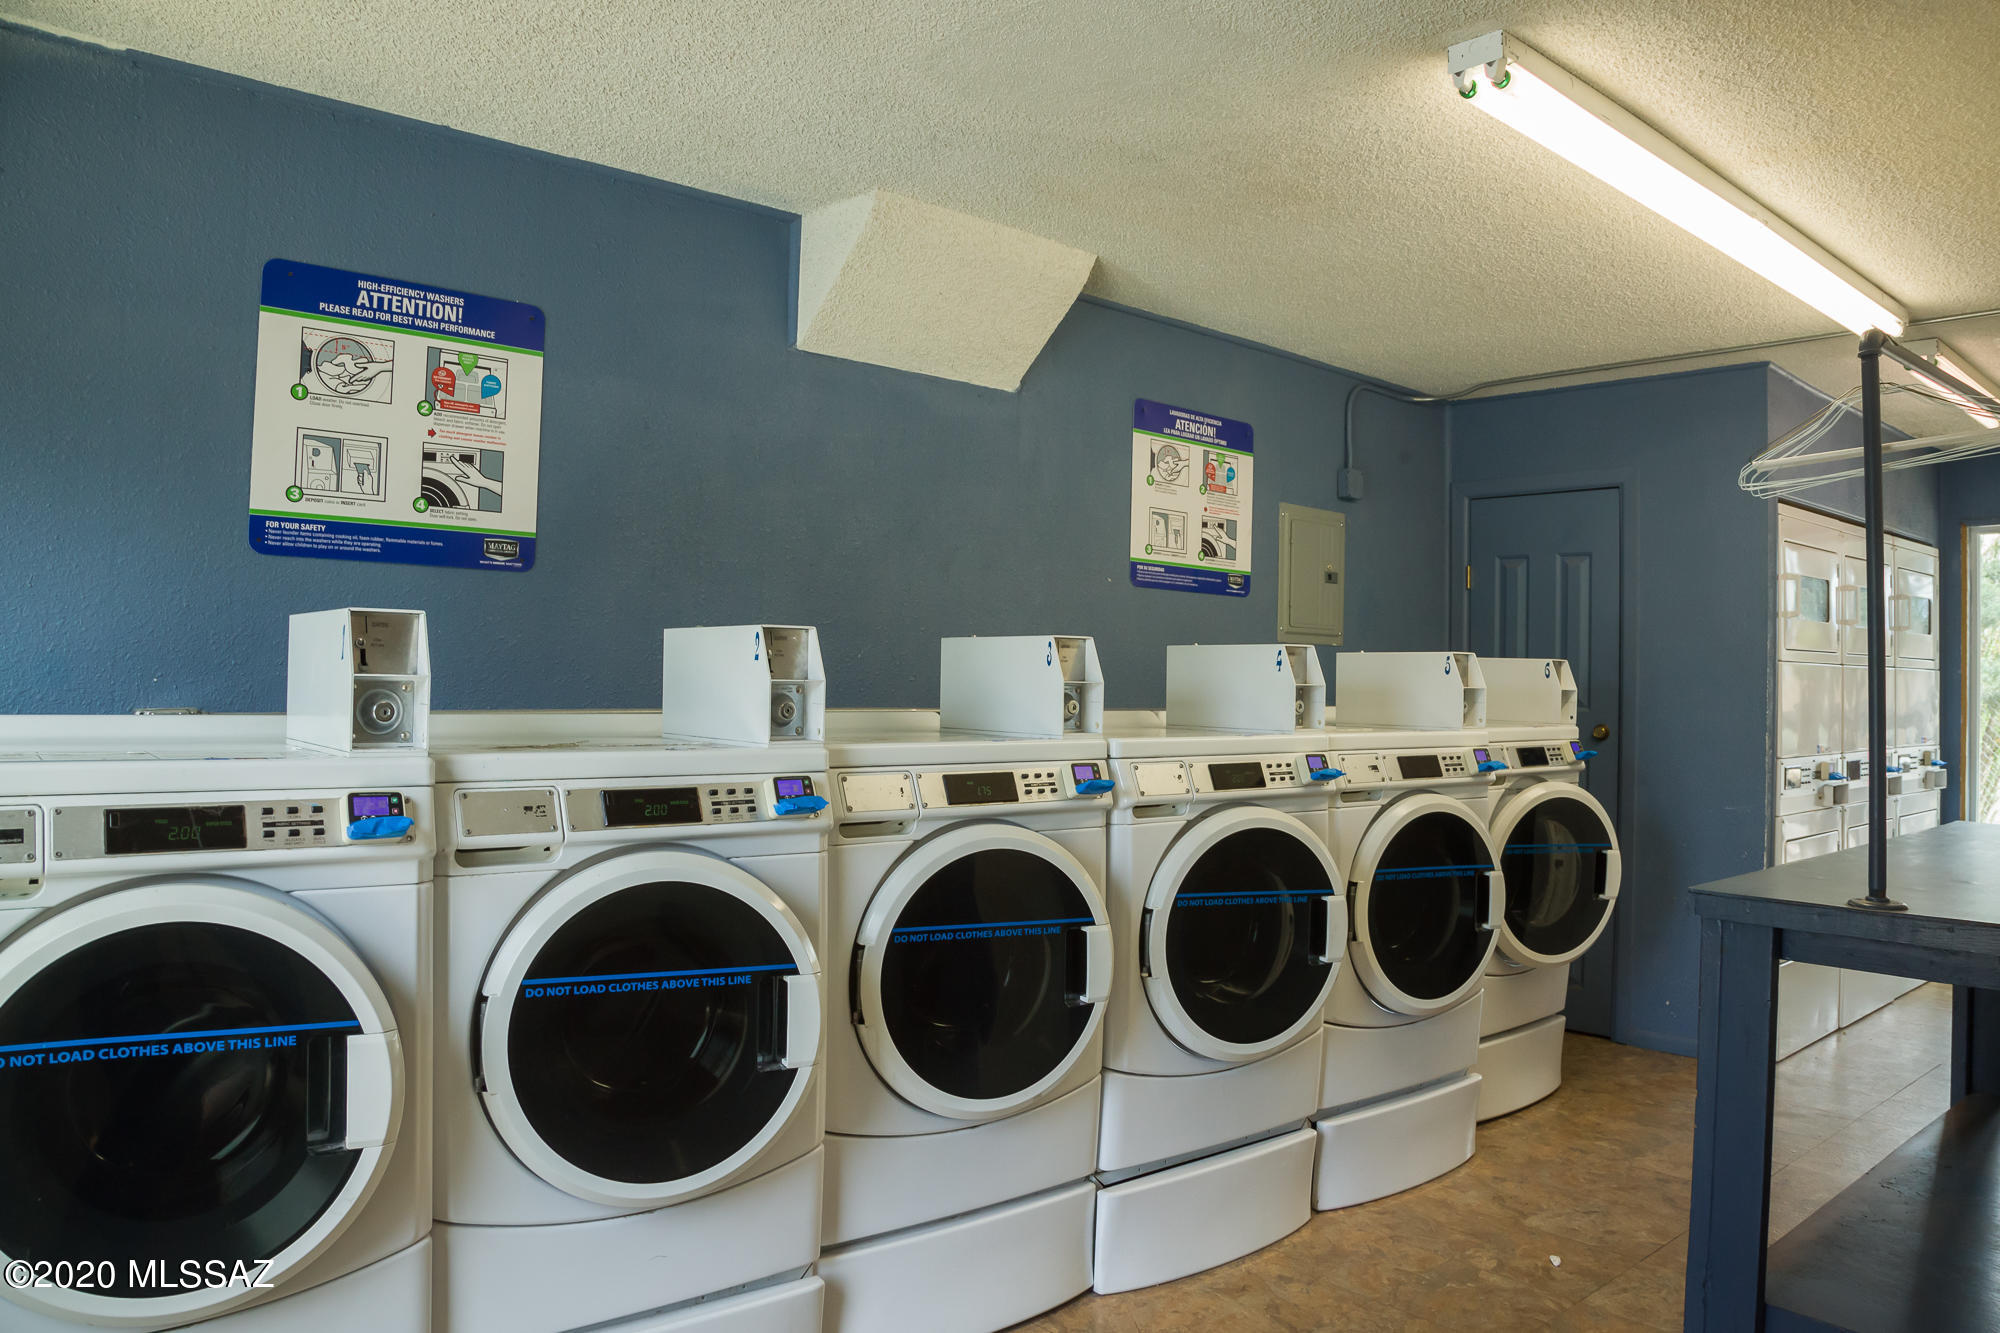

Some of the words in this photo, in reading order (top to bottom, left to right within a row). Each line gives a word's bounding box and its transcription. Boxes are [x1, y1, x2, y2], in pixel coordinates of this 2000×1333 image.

[357, 280, 425, 299] HIGH-EFFICIENCY
[426, 292, 465, 306] WASHERS
[356, 289, 463, 323] ATTENTION!
[319, 302, 351, 315] PLEASE
[352, 307, 374, 319] READ
[375, 311, 391, 321] FOR
[392, 315, 412, 325] BEST
[414, 318, 439, 329] WASH
[440, 322, 496, 339] PERFORMANCE
[295, 386, 303, 397] 1
[420, 402, 429, 414] 2
[1175, 418, 1216, 438] ATENCIÓN!
[289, 488, 300, 499] 3
[415, 500, 426, 510] 4
[265, 520, 279, 529] FOR
[280, 522, 300, 531] YOUR
[300, 523, 326, 532] SAFETY
[487, 542, 516, 551] MAYTAG
[754, 631, 760, 661] 2
[1046, 640, 1052, 667] 3
[1544, 662, 1550, 679] 6
[168, 826, 200, 840] 2.00
[1189, 899, 1203, 907] NOT
[1204, 898, 1224, 906] LOAD
[1224, 897, 1254, 905] CLOTHES
[894, 934, 908, 943] DO
[909, 933, 928, 943] NOT
[929, 931, 953, 941] LOAD
[955, 929, 993, 940] CLOTHES
[994, 928, 1023, 938] ABOVE
[1023, 927, 1042, 936] THIS
[1043, 926, 1061, 935] LINE
[525, 987, 545, 999] DO
[546, 986, 573, 997] NOT
[573, 984, 606, 996] LOAD
[608, 979, 659, 993] CLOTHES
[661, 977, 700, 990] ABOVE
[701, 975, 726, 987] THIS
[727, 974, 752, 985] LINE
[9, 1052, 47, 1068] NOT
[49, 1049, 95, 1065] LOAD
[98, 1044, 170, 1061] CLOTHES
[173, 1040, 225, 1056] ABOVE
[227, 1037, 260, 1050] THIS
[264, 1034, 297, 1048] LINE
